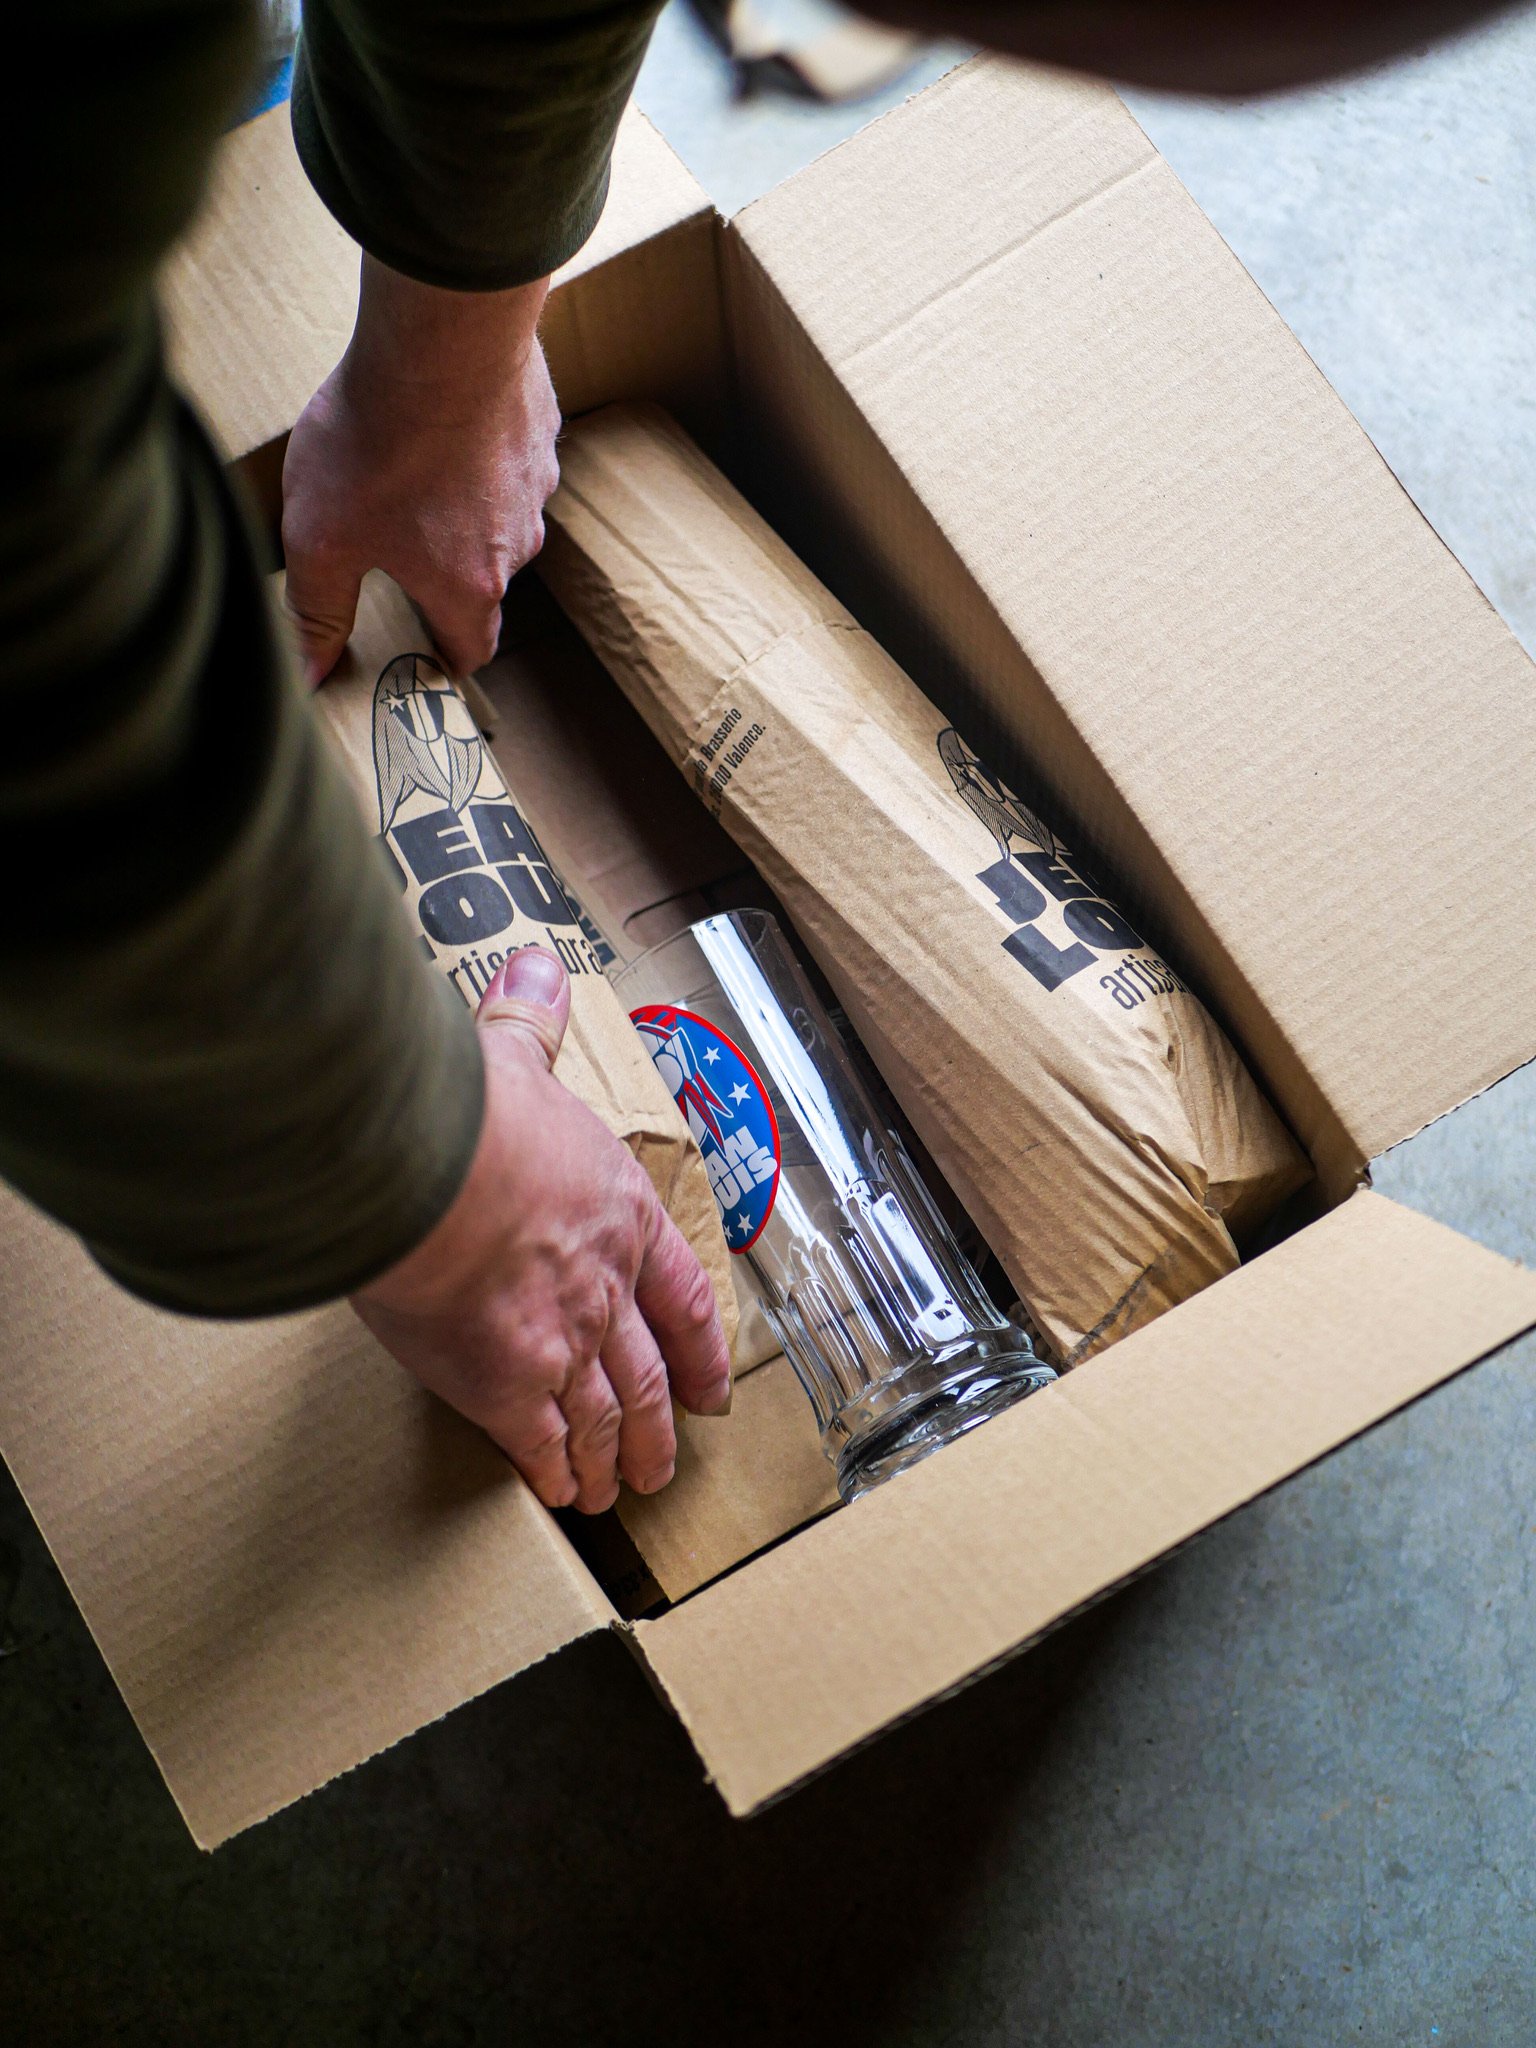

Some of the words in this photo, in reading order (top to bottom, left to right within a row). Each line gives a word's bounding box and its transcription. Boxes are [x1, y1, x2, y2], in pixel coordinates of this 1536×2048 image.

[700, 708, 742, 762] Brasserie
[723, 723, 766, 769] Valence.
[383, 803, 552, 897] EA
[1001, 898, 1145, 993] LO
[1099, 953, 1187, 1010] artisa
[704, 1125, 759, 1188] AN
[714, 1145, 778, 1210] UIS
